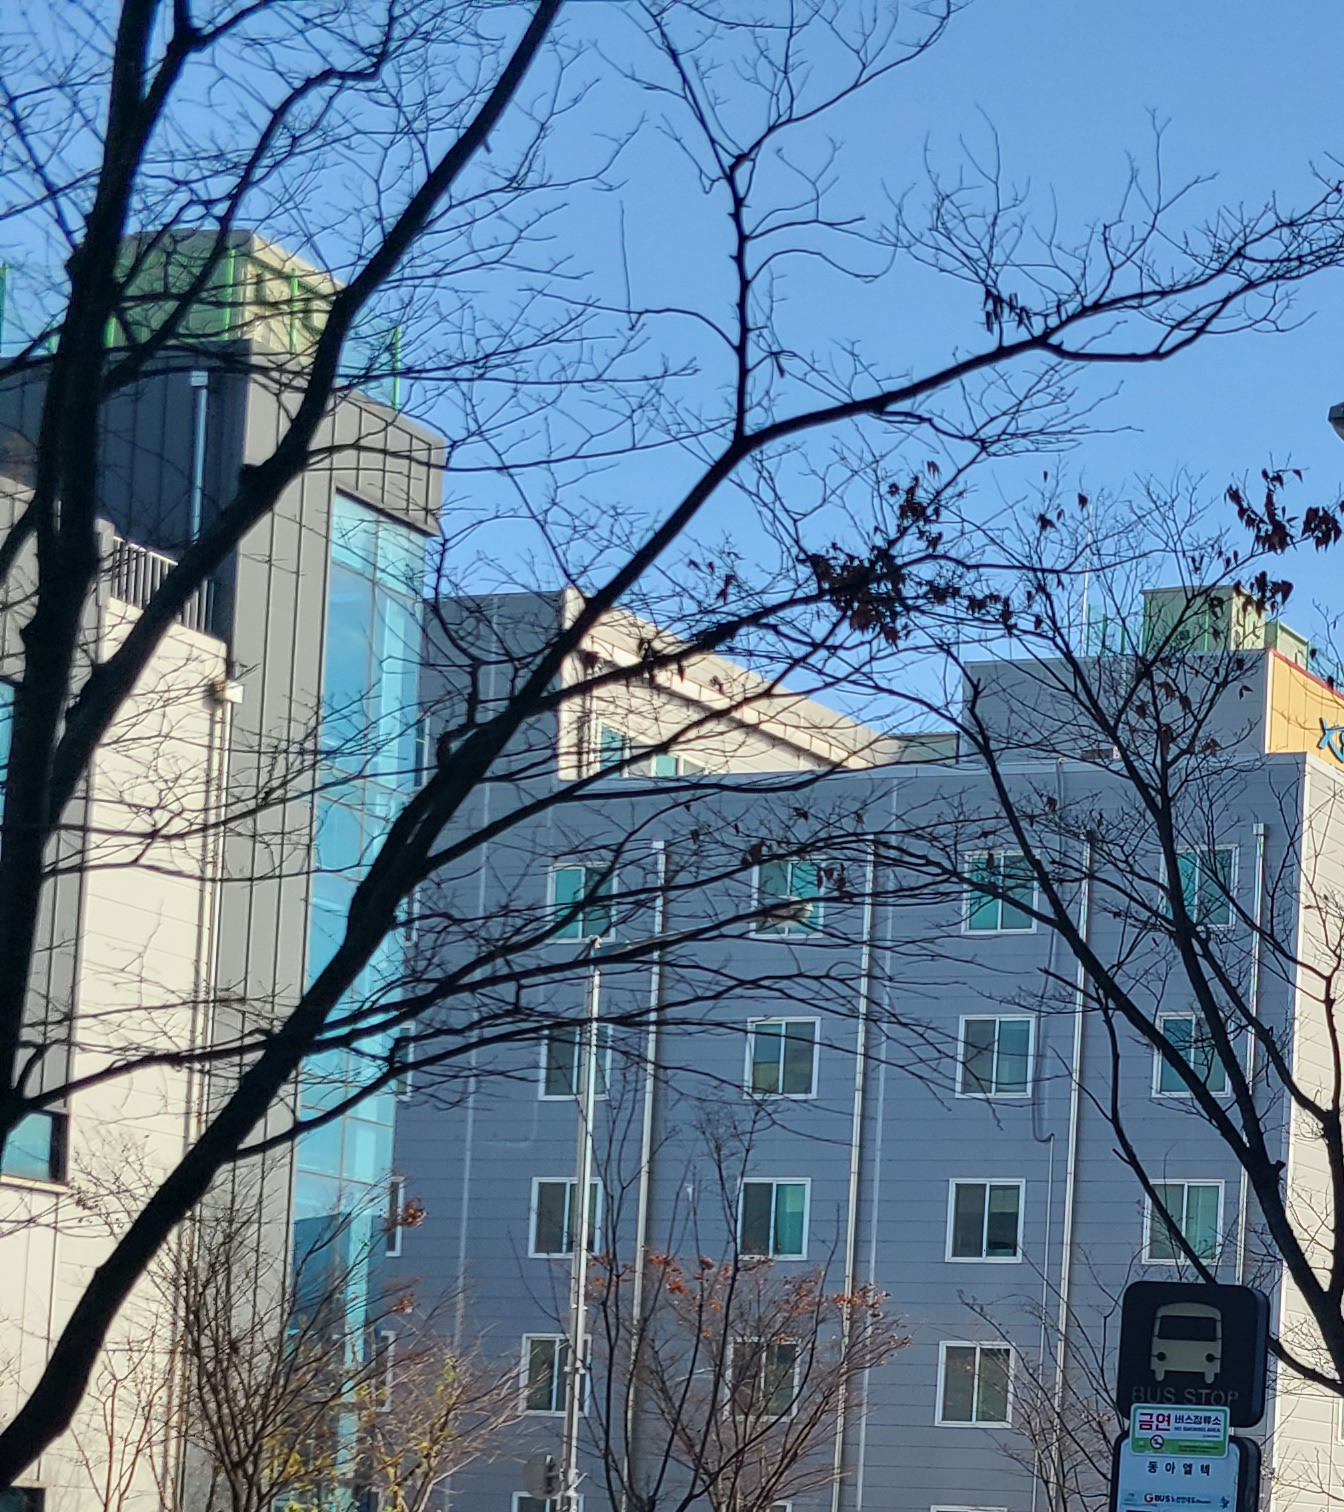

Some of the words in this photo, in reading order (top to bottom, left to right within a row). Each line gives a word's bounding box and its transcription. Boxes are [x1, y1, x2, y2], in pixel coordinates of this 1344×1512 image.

[1132, 1387, 1175, 1403] BUS
[1184, 1389, 1238, 1405] STOP
[1138, 1412, 1171, 1432] 금연
[1174, 1414, 1222, 1426] 버스정류소
